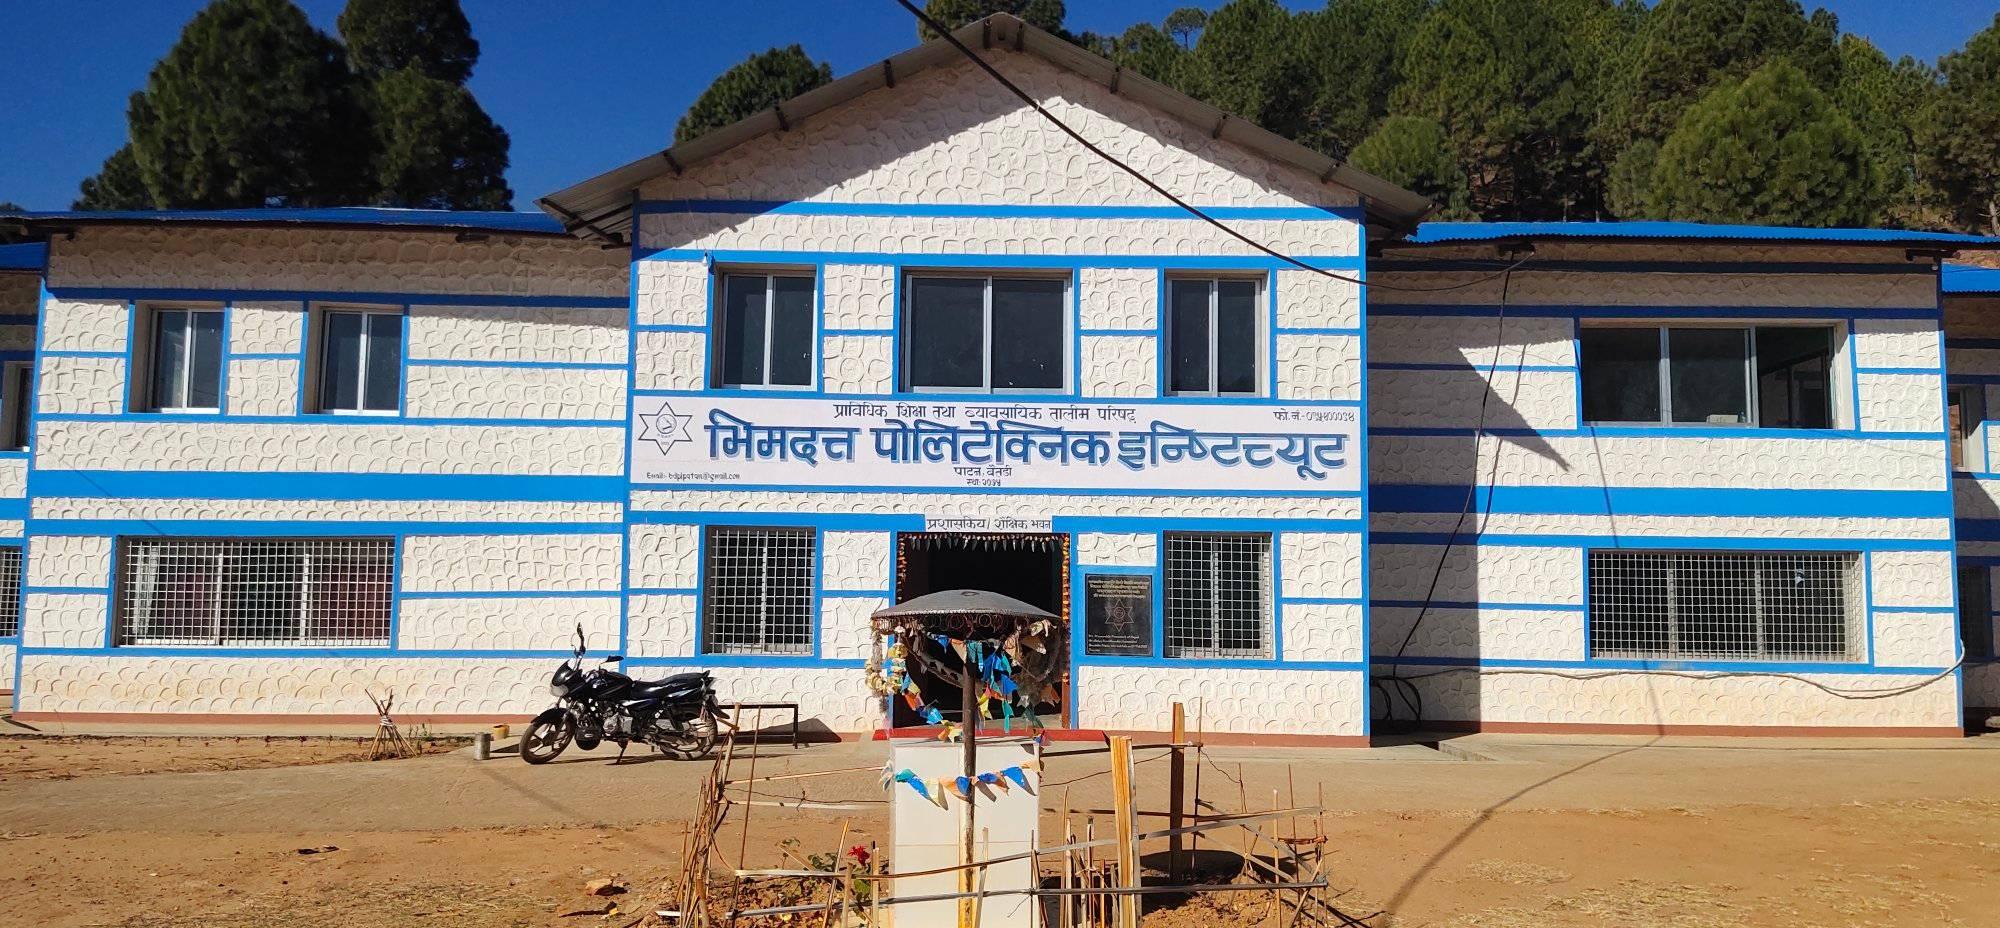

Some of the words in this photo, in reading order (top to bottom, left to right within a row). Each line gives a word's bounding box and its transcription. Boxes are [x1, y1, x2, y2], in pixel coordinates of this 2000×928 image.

[832, 401, 888, 419] प्राविधिक
[896, 402, 927, 419] शिक्षा
[932, 406, 956, 420] तथा
[964, 404, 1043, 420] व्यावसायिक
[1049, 405, 1091, 422] तालीम
[703, 408, 862, 467] भिमदत्त
[869, 418, 1113, 466] पोलिटेक्निक
[1030, 519, 1051, 530] भवन
